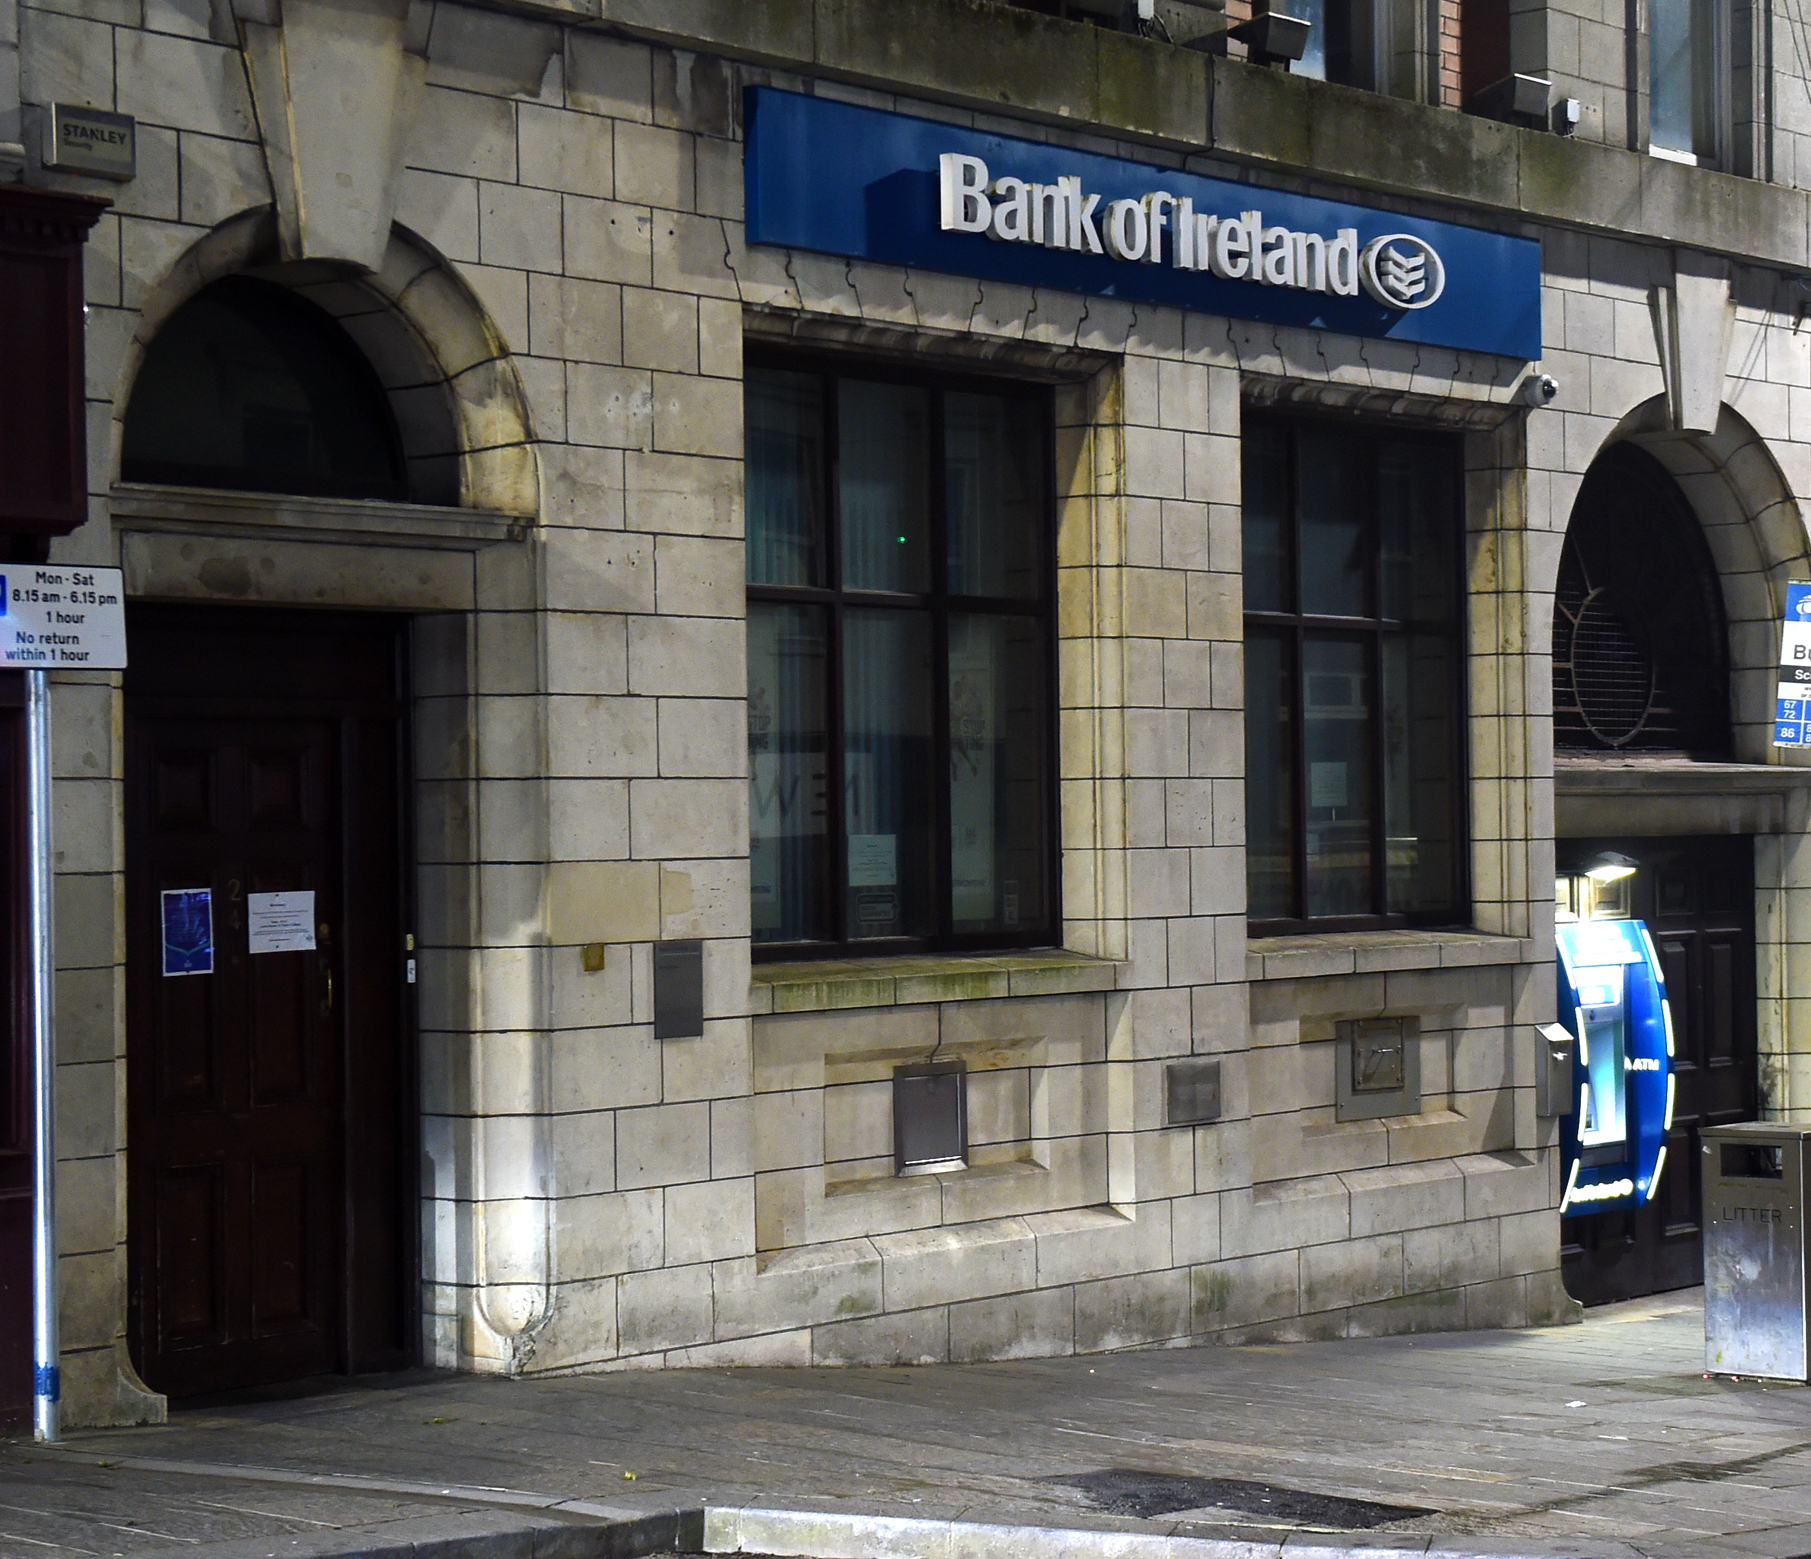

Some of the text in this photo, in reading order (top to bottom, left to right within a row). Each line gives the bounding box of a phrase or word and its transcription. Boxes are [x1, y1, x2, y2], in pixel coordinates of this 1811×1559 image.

[63, 123, 126, 145] STANLEY
[939, 152, 1359, 296] Bank of Ireland
[35, 571, 63, 584] Mon
[72, 573, 95, 586] Sat
[12, 589, 39, 602] 8.15
[41, 592, 60, 602] am
[70, 591, 96, 604] 6.15
[98, 594, 117, 606] pm
[46, 611, 85, 624] 1 hour
[16, 631, 80, 645] No return
[5, 647, 90, 661] within 1 hour
[1794, 669, 1811, 681] Sc
[1783, 700, 1797, 709] 67
[1783, 710, 1796, 719] 72
[1780, 728, 1795, 738] 86
[1632, 1057, 1660, 1071] ATM
[1722, 1206, 1783, 1224] LITTER
